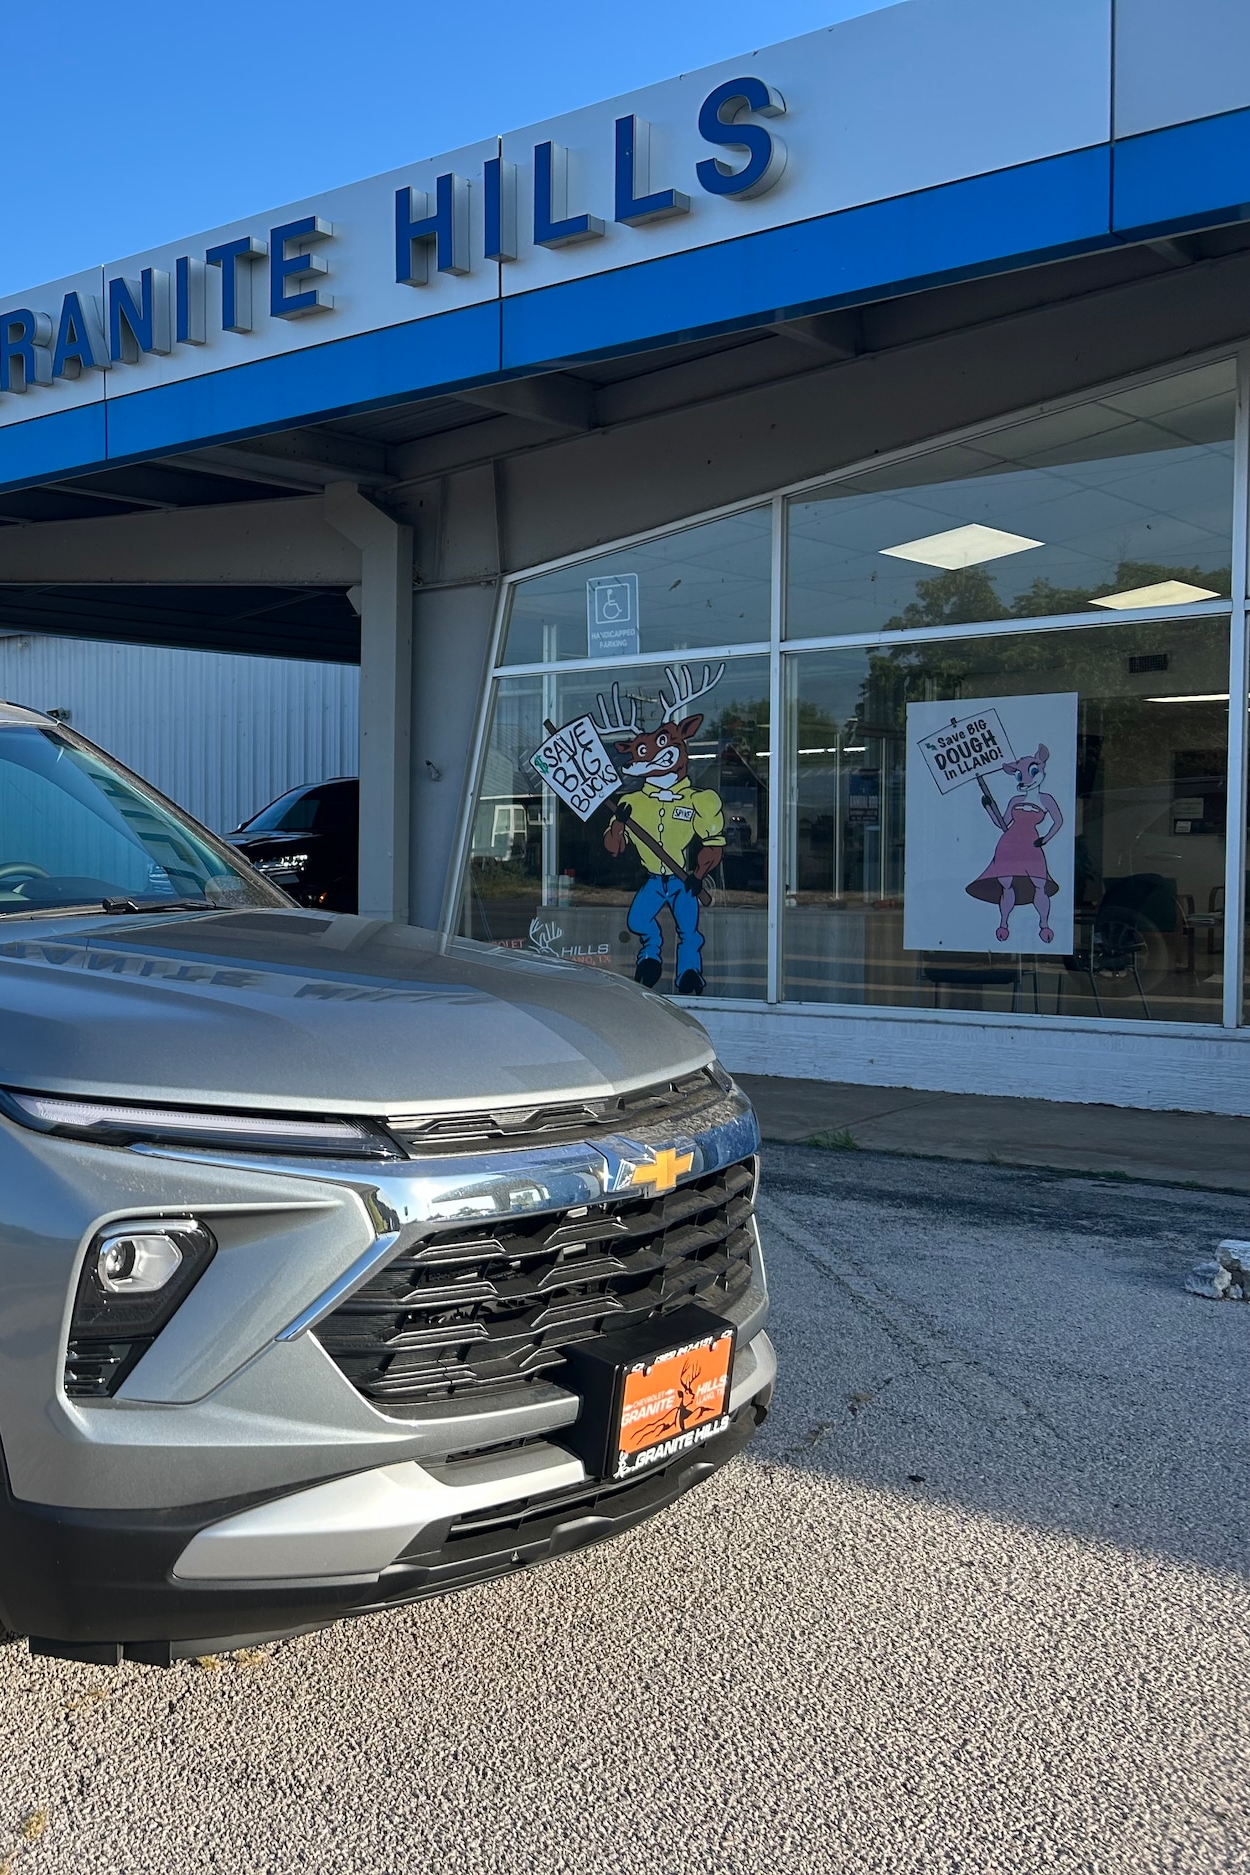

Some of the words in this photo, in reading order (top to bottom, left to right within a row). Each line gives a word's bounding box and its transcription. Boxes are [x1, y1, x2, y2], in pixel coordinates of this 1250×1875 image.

[395, 76, 788, 287] HILLS
[591, 628, 636, 640] HANDICAPPED
[599, 639, 628, 649] PARKING
[937, 731, 966, 748] Save
[966, 719, 988, 735] BIG
[934, 729, 998, 771] DOUGH
[943, 769, 957, 781] in
[957, 746, 1004, 775] LLANO!
[552, 746, 601, 793] BIG
[570, 764, 618, 813] BUCKS
[561, 943, 609, 957] HILLS
[632, 1389, 666, 1409] CHEVROLET
[695, 1374, 728, 1397] HILLS
[621, 1395, 677, 1427] GRANITE
[634, 1430, 695, 1468] GRANITE
[694, 1414, 730, 1443] HILLS
